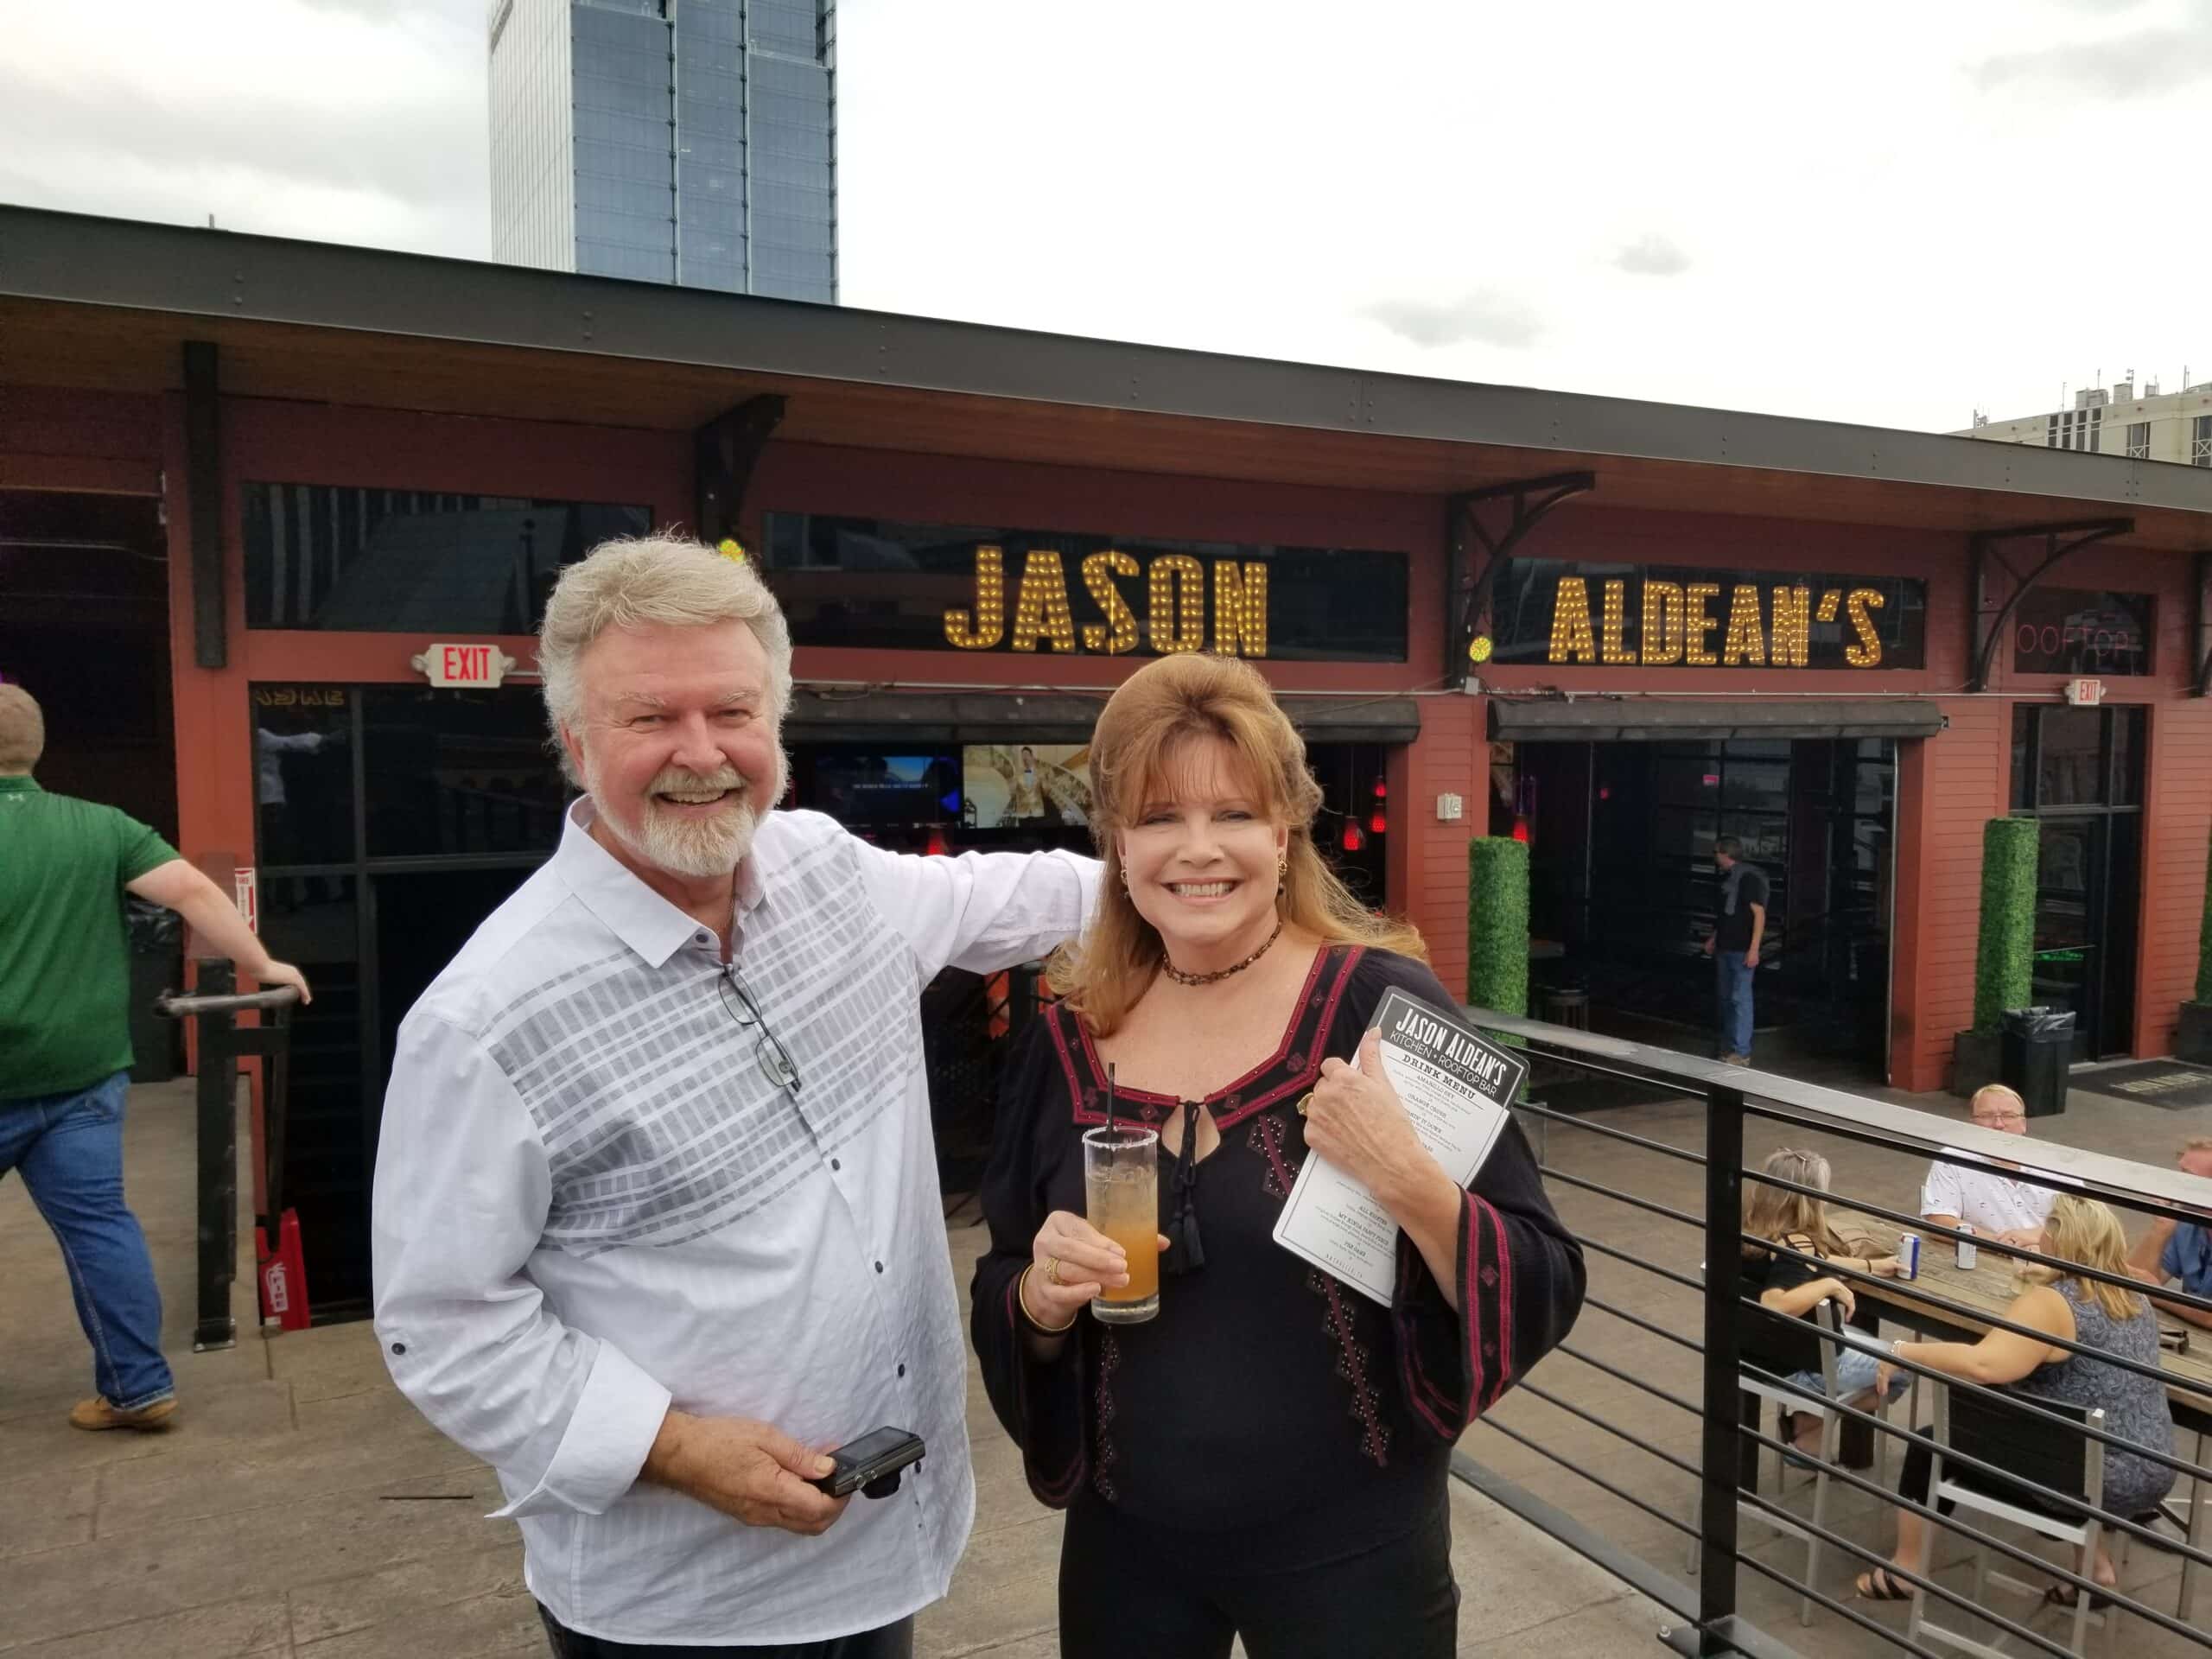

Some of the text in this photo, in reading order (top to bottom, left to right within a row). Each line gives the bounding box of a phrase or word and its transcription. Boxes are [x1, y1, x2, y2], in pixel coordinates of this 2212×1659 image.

[944, 545, 1885, 667] JASON ALDEAN'S
[443, 646, 492, 681] EXIT
[2079, 681, 2098, 702] EXIT
[1389, 1030, 1433, 1058] KITCHEN
[1437, 1055, 1480, 1084] ROOFTOP
[1478, 1081, 1497, 1097] BAR
[1395, 1008, 1507, 1086] JASON ALDEAN'S
[1402, 1054, 1441, 1079] DRINK
[1443, 1077, 1476, 1099] MENU
